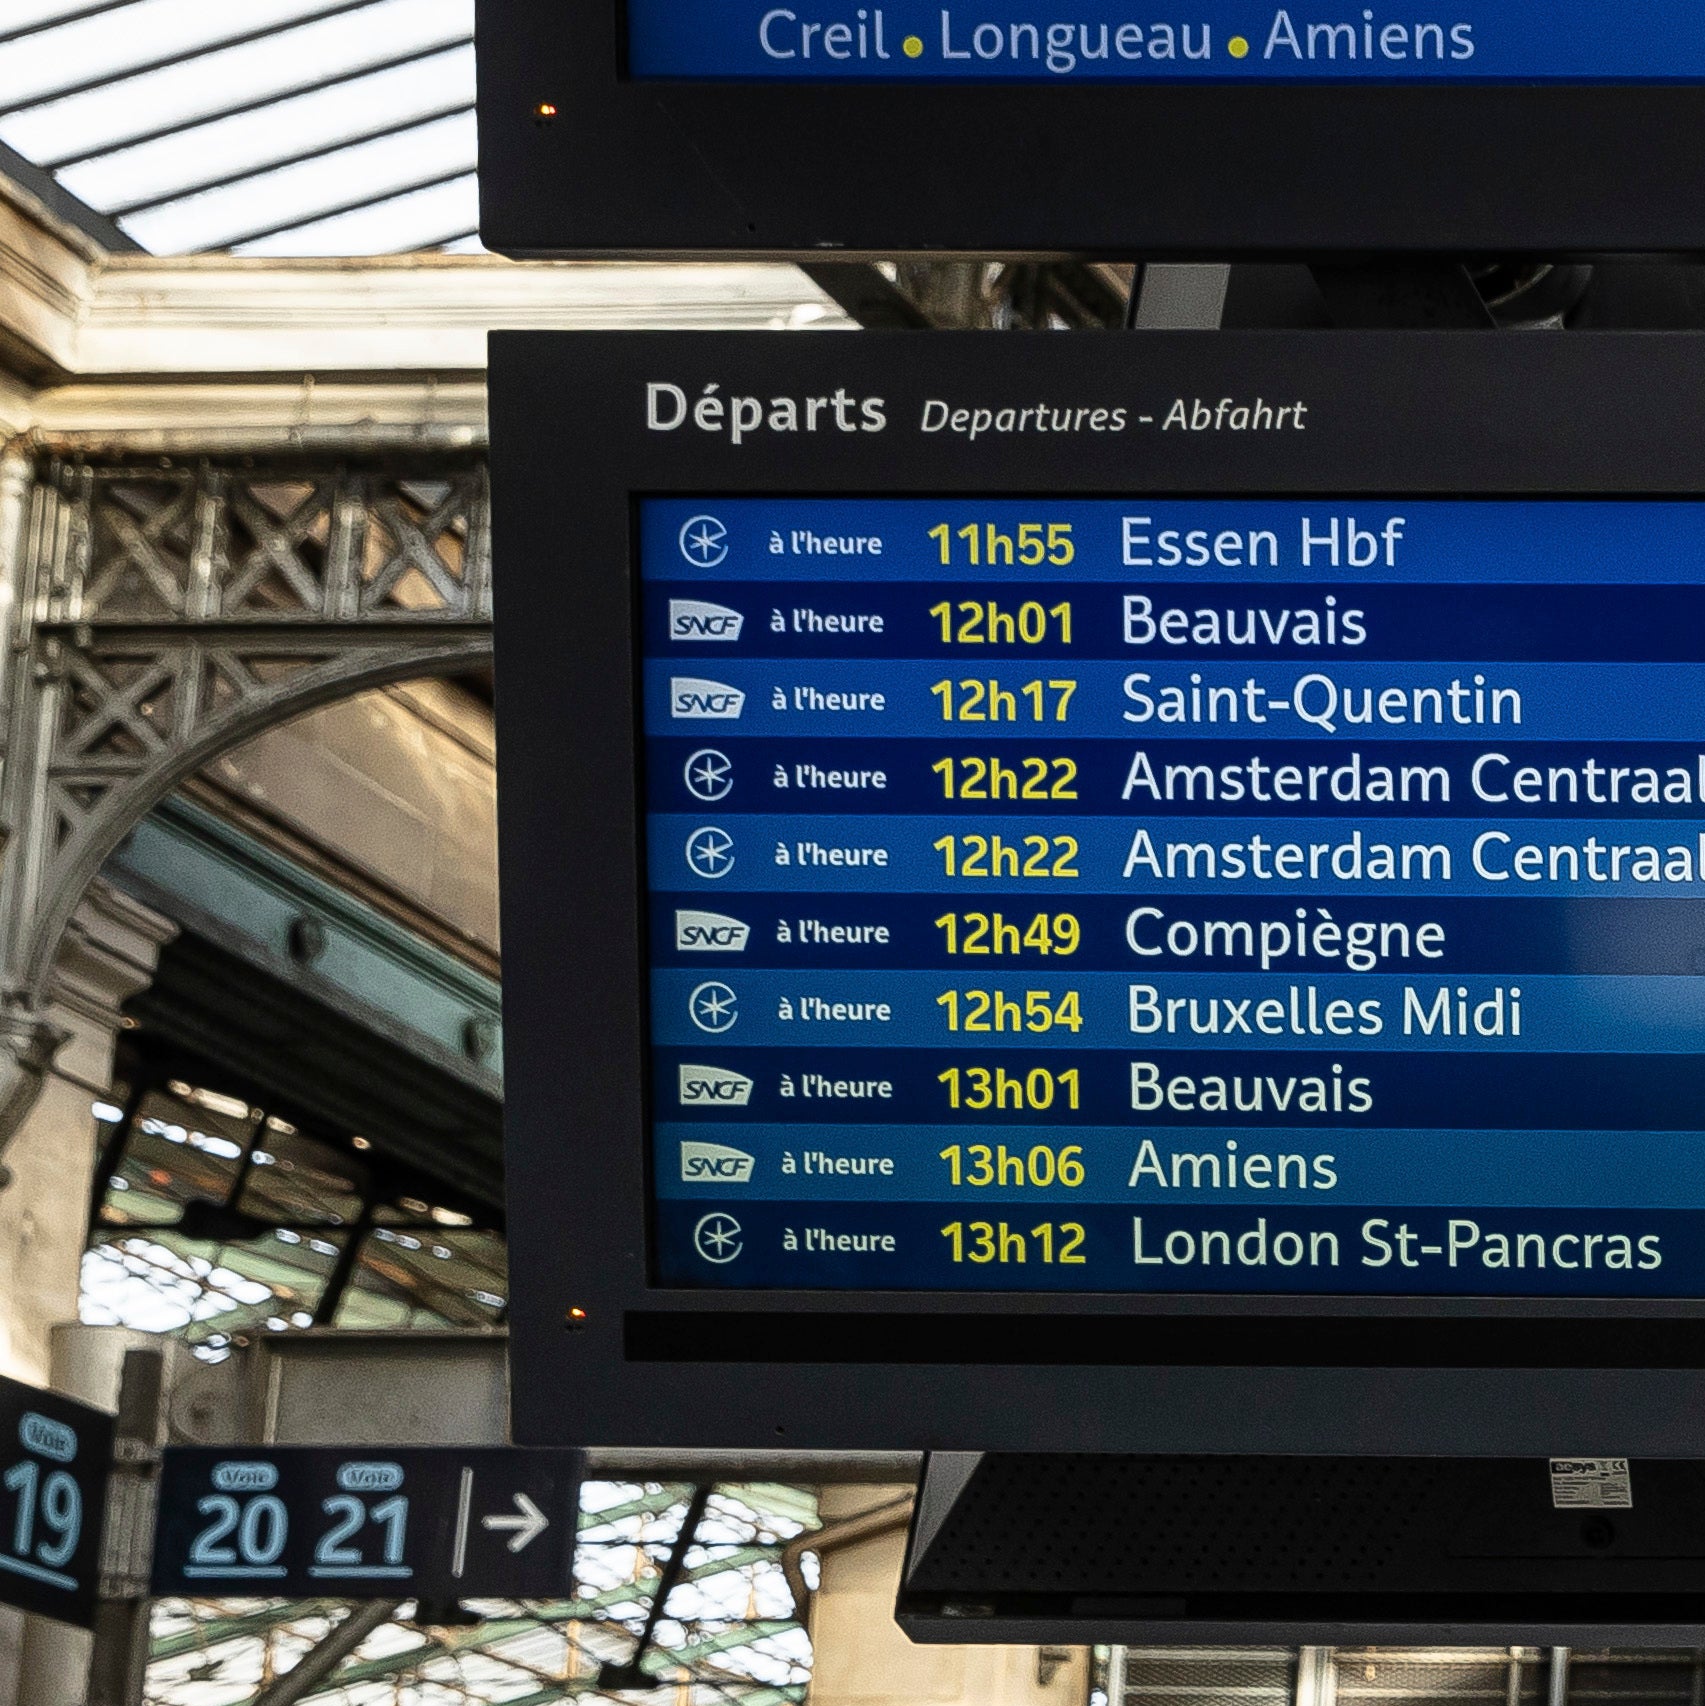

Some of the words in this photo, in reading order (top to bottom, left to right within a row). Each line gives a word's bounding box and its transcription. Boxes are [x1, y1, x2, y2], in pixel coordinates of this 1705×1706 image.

[761, 10, 889, 57] Creil
[943, 11, 1210, 72] Longueau
[1265, 11, 1473, 58] Amiens
[647, 383, 887, 444] Départs
[921, 401, 1126, 440] Departures
[1163, 398, 1307, 430] Abfahrt
[770, 531, 783, 553] à
[792, 532, 881, 554] l'heure
[928, 524, 1074, 565] 11h55
[1123, 518, 1277, 566] Essen
[1303, 518, 1405, 566] Hbf
[674, 616, 738, 635] SNCF
[772, 609, 785, 631] à
[794, 610, 883, 632] l'heure
[930, 602, 1071, 643] 12h01
[1124, 596, 1366, 644] Beauvais
[676, 694, 740, 713] SNCF
[773, 687, 786, 709] à
[795, 687, 885, 710] l'heure
[931, 680, 1076, 721] 12h17
[1124, 674, 1520, 733] Saint-Quentin
[774, 765, 788, 787] à
[797, 765, 886, 788] l'heure
[933, 758, 1077, 799] 12h22
[1122, 752, 1449, 801] Amsterdam
[776, 843, 789, 864] à
[798, 843, 887, 865] l'heure
[934, 835, 1078, 877] 12h22
[1123, 830, 1450, 879] Amsterdam
[680, 926, 744, 945] SNCF
[777, 920, 791, 942] à
[800, 920, 889, 943] l'heure
[935, 913, 1080, 955] 12h49
[1127, 908, 1444, 968] Compiègne
[779, 998, 793, 1019] à
[802, 998, 890, 1020] l'heure
[937, 990, 1083, 1032] 12h54
[1130, 985, 1382, 1034] Bruxelles
[1404, 987, 1520, 1035] Midi
[683, 1080, 747, 1099] SNCF
[781, 1075, 794, 1096] à
[803, 1075, 892, 1097] l'heure
[938, 1068, 1078, 1109] 13h01
[1131, 1063, 1372, 1112] Beauvais
[685, 1157, 748, 1176] SNCF
[782, 1152, 795, 1173] à
[805, 1152, 893, 1174] l'heure
[940, 1145, 1084, 1186] 13h06
[1129, 1140, 1337, 1189] Amiens
[784, 1229, 797, 1250] à
[806, 1229, 895, 1251] l'heure
[941, 1222, 1085, 1263] 13h12
[1135, 1217, 1338, 1265] London
[1362, 1219, 1661, 1269] St-Pancras
[4, 1461, 82, 1567] 19
[189, 1495, 289, 1566] 20
[314, 1495, 409, 1566] 21
